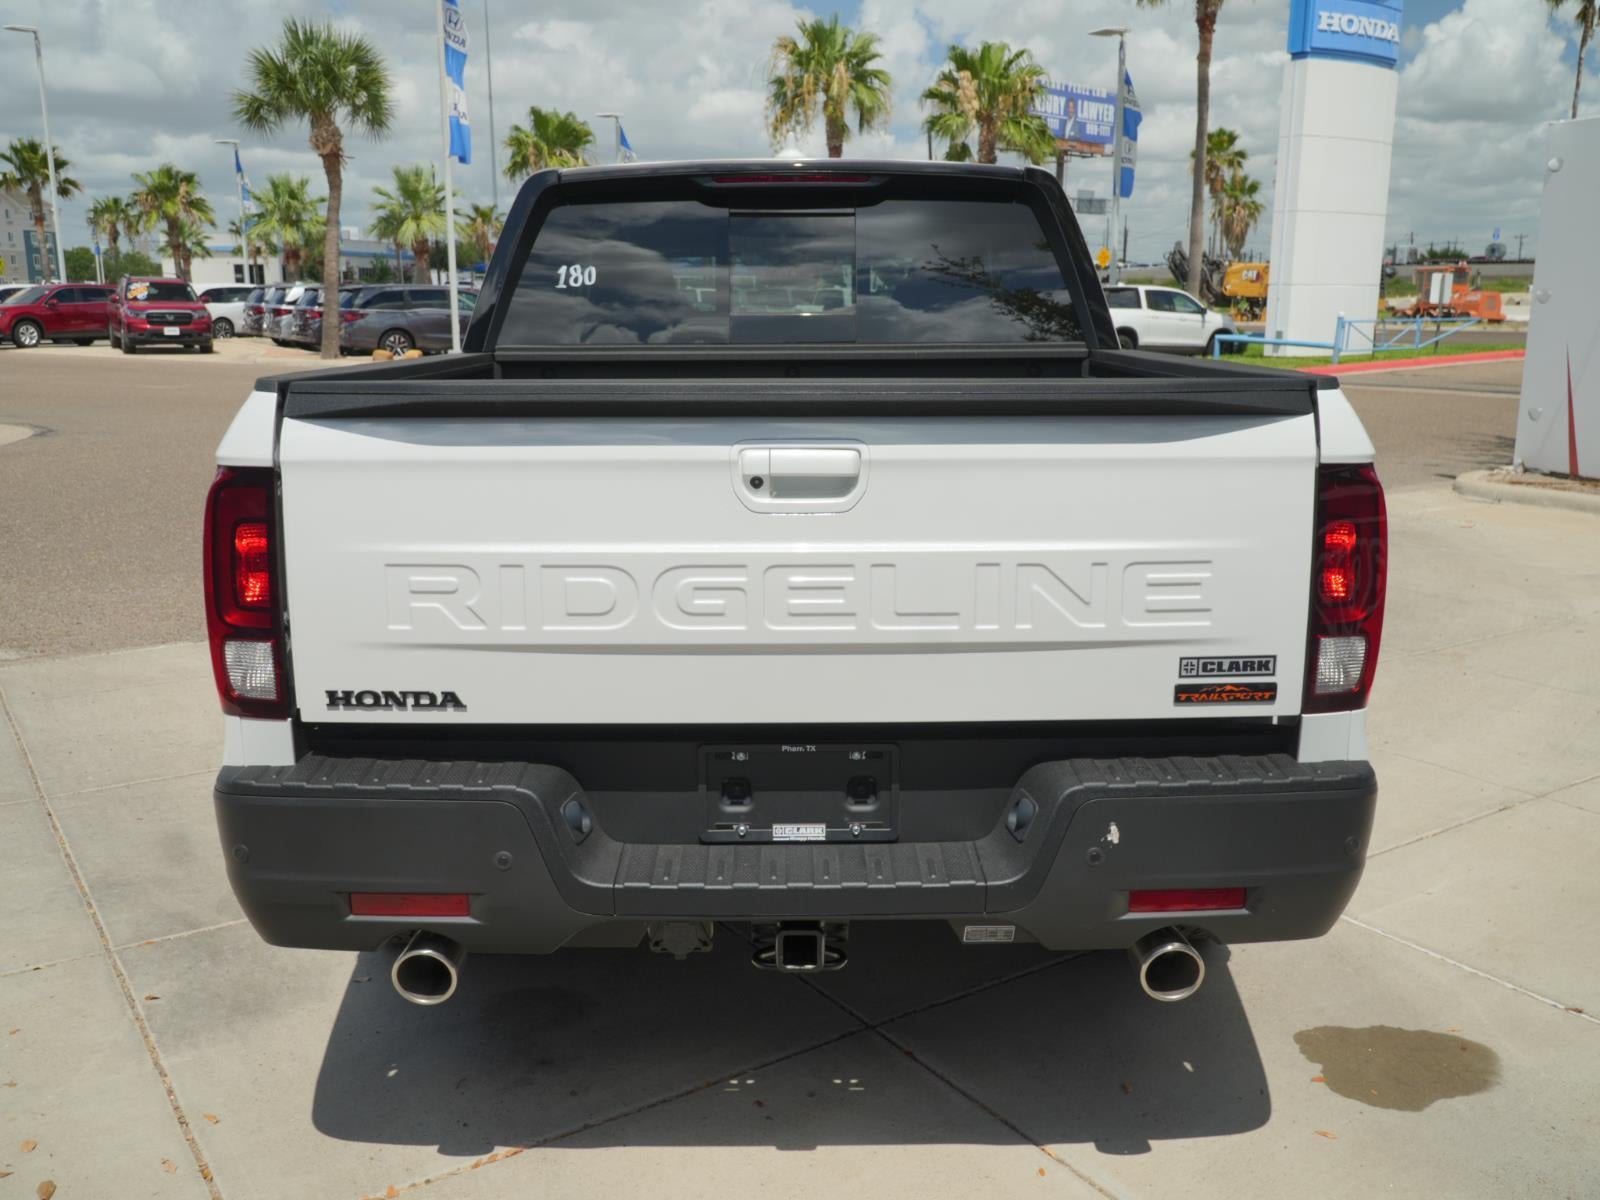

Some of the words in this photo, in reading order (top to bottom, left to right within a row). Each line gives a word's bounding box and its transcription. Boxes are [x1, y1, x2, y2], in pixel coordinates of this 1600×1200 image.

[444, 28, 467, 48] NDA
[1317, 11, 1399, 43] HONDA
[1077, 98, 1114, 123] LAWYER
[555, 264, 596, 288] 180
[384, 560, 1213, 632] RIDGELINE
[1201, 660, 1271, 673] CLARK
[325, 690, 467, 711] HONDA
[806, 744, 816, 752] TX
